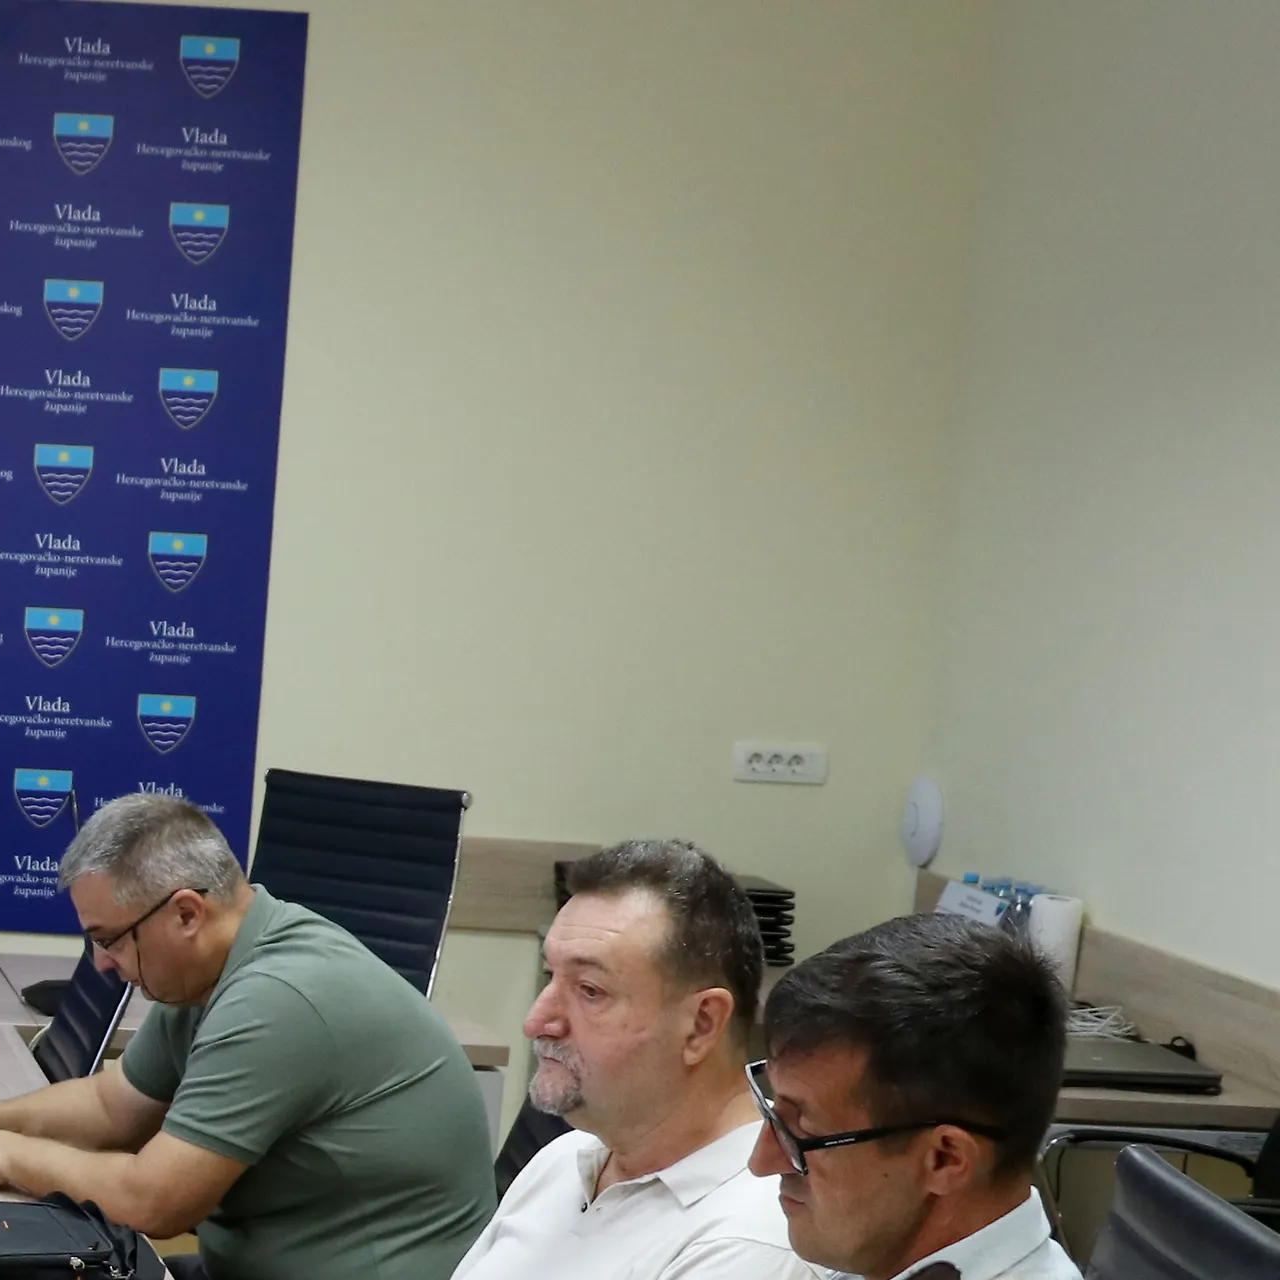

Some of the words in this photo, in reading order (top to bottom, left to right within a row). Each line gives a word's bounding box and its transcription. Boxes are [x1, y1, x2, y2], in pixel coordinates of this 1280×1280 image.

[64, 37, 110, 55] Vlada
[64, 69, 107, 83] županije
[182, 127, 227, 145] Vlada
[181, 159, 224, 173] županije
[55, 204, 101, 222] Vlada
[54, 236, 97, 250] županije
[171, 293, 216, 311] Vlada
[171, 325, 213, 339] županije
[45, 369, 91, 387] Vlada
[44, 401, 87, 414] županije
[161, 458, 206, 475] Vlada
[160, 489, 202, 503] županije
[35, 533, 80, 551] Vlada
[35, 564, 77, 578] županije
[150, 621, 194, 638] Vlada
[149, 652, 191, 665] županije
[25, 696, 70, 713] Vlada
[25, 727, 67, 739] županije
[14, 855, 58, 871] Vlada
[13, 885, 55, 899] županije
